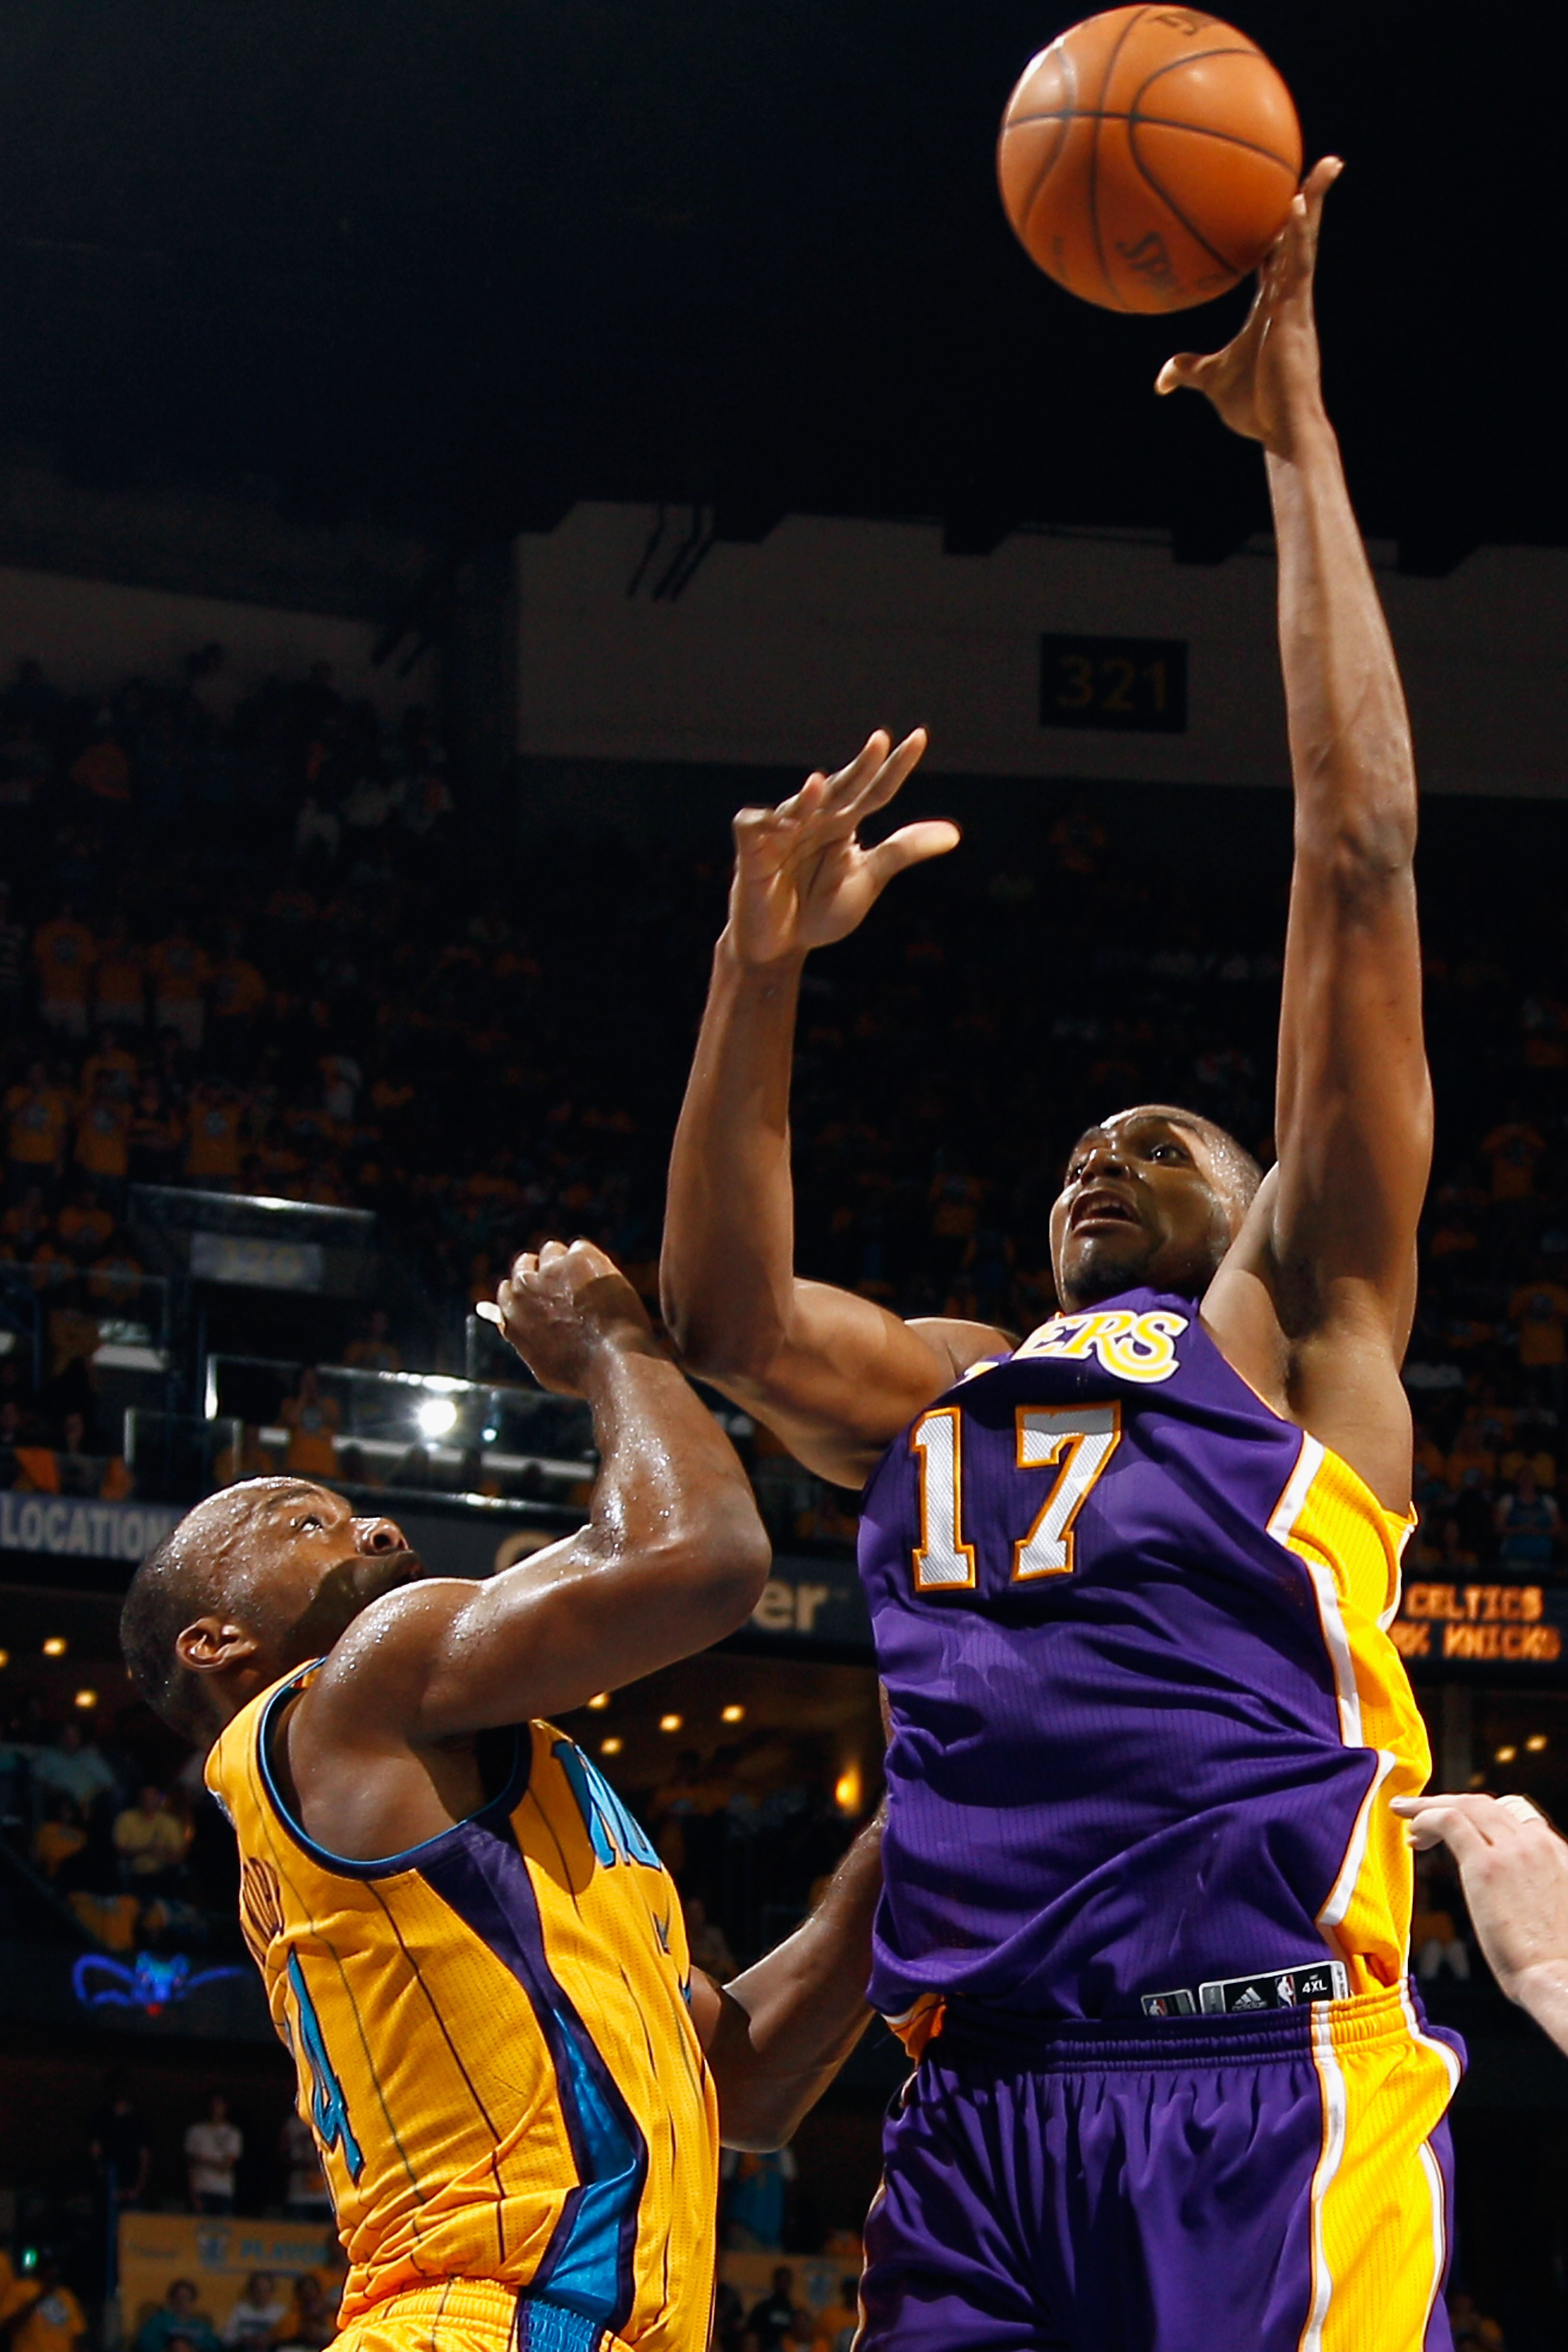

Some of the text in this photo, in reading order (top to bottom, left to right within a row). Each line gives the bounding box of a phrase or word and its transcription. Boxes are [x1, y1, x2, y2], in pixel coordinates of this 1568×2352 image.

[1056, 653, 1168, 712] 321
[961, 1310, 1189, 1384] ERS
[911, 1400, 1121, 1592] 17
[753, 1579, 829, 1632] er
[1406, 1583, 1543, 1621] CELTICS
[1302, 1980, 1327, 1993] 4XL
